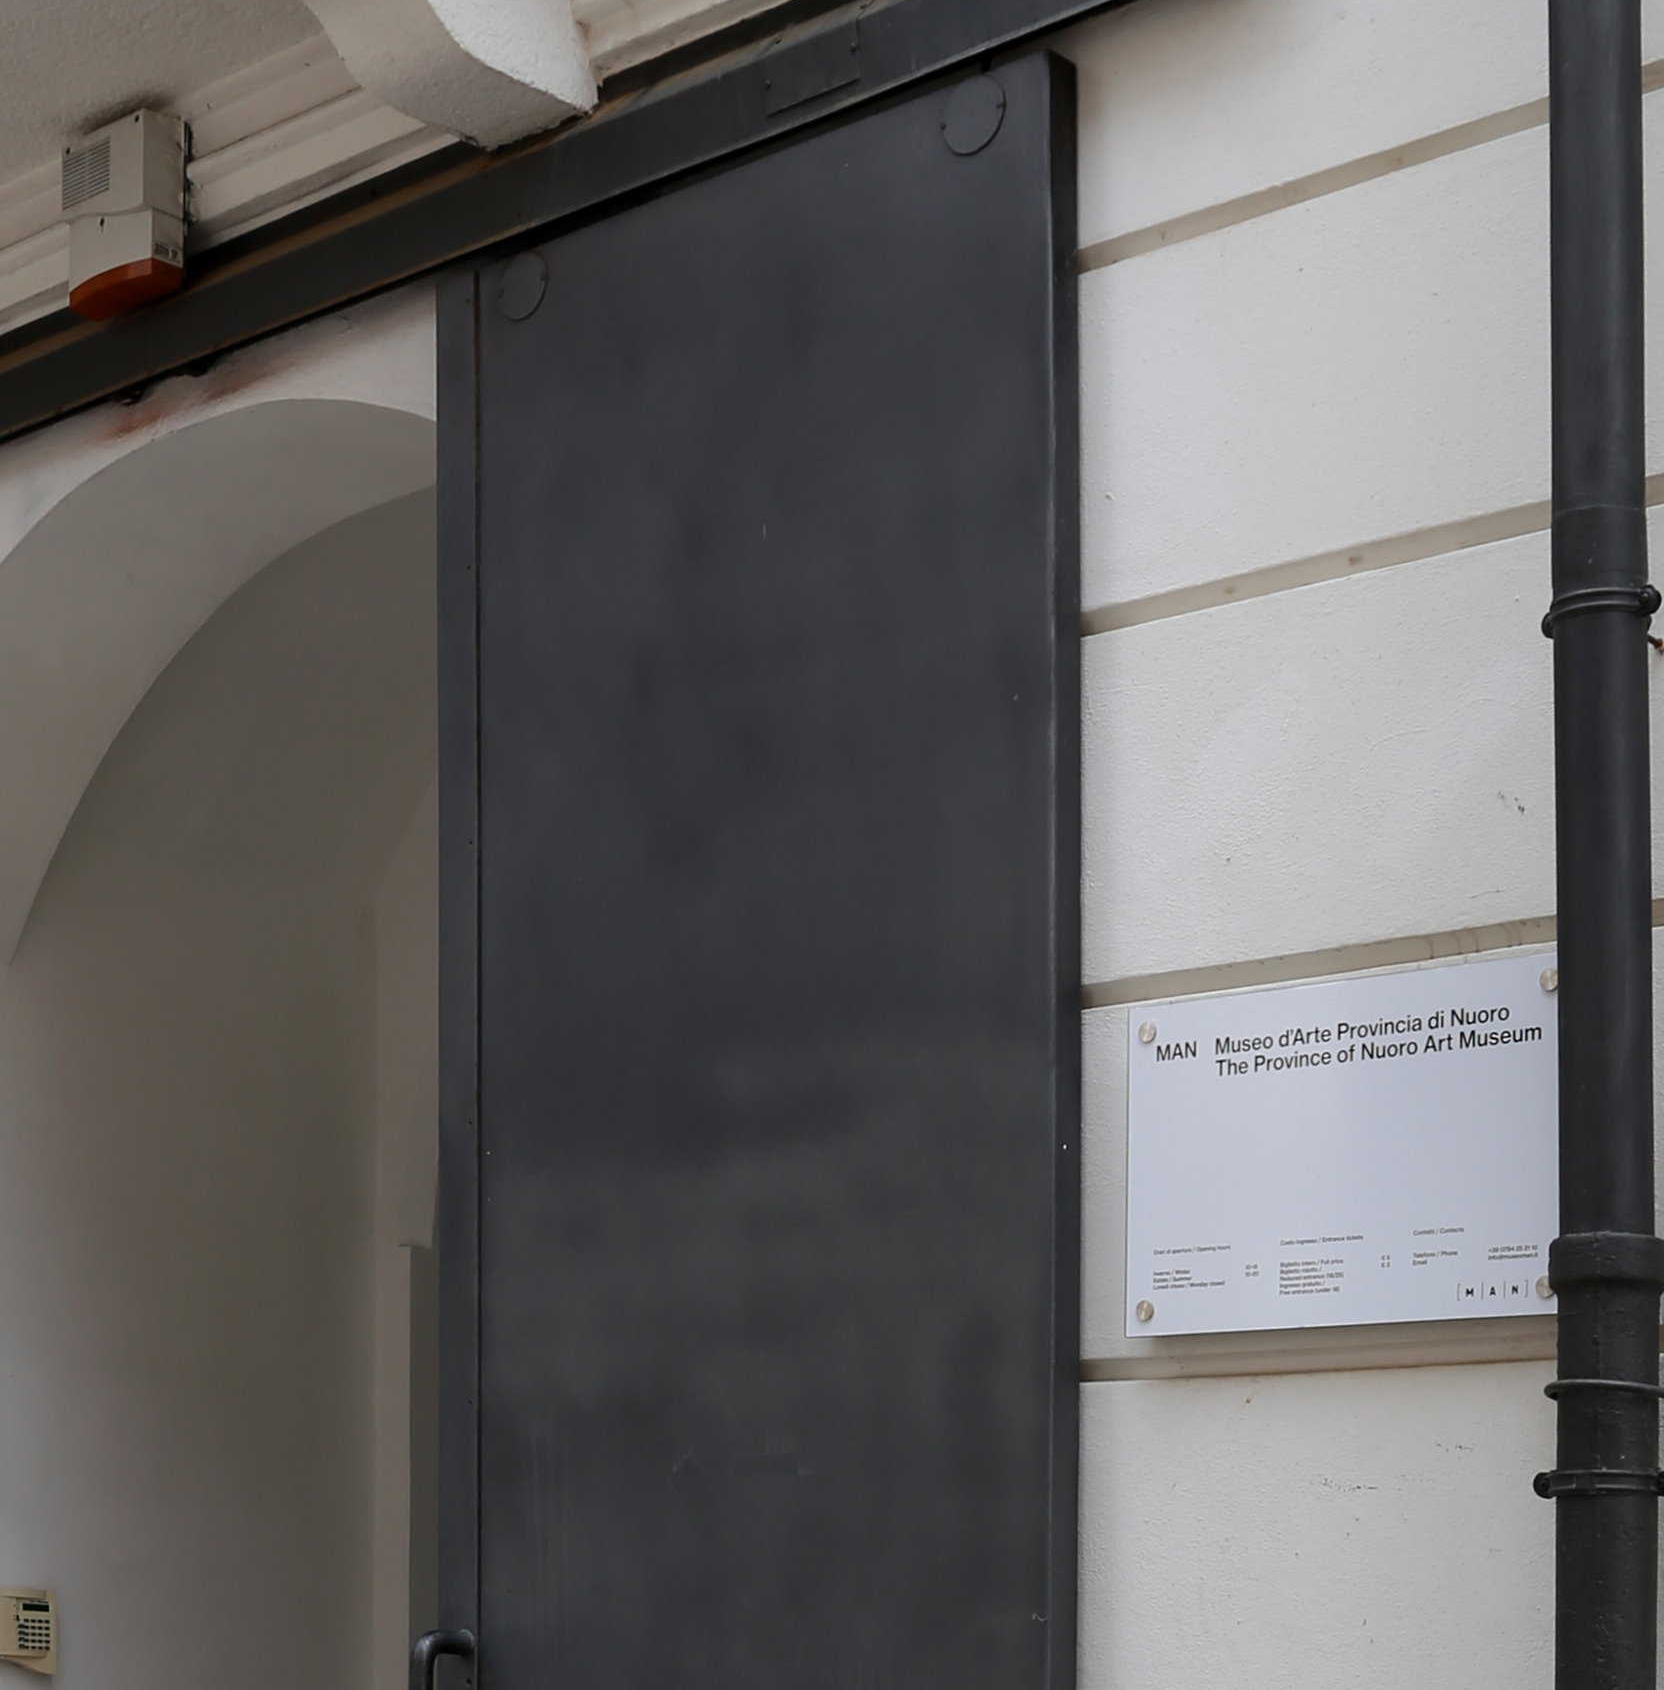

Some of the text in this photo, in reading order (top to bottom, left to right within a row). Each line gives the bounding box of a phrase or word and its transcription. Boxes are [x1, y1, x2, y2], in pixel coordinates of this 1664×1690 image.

[1156, 1007, 1510, 1062] MAN Museo d'Arte Provincia di Nuoro
[1216, 1026, 1542, 1077] The Province of Nuoro Art Museum
